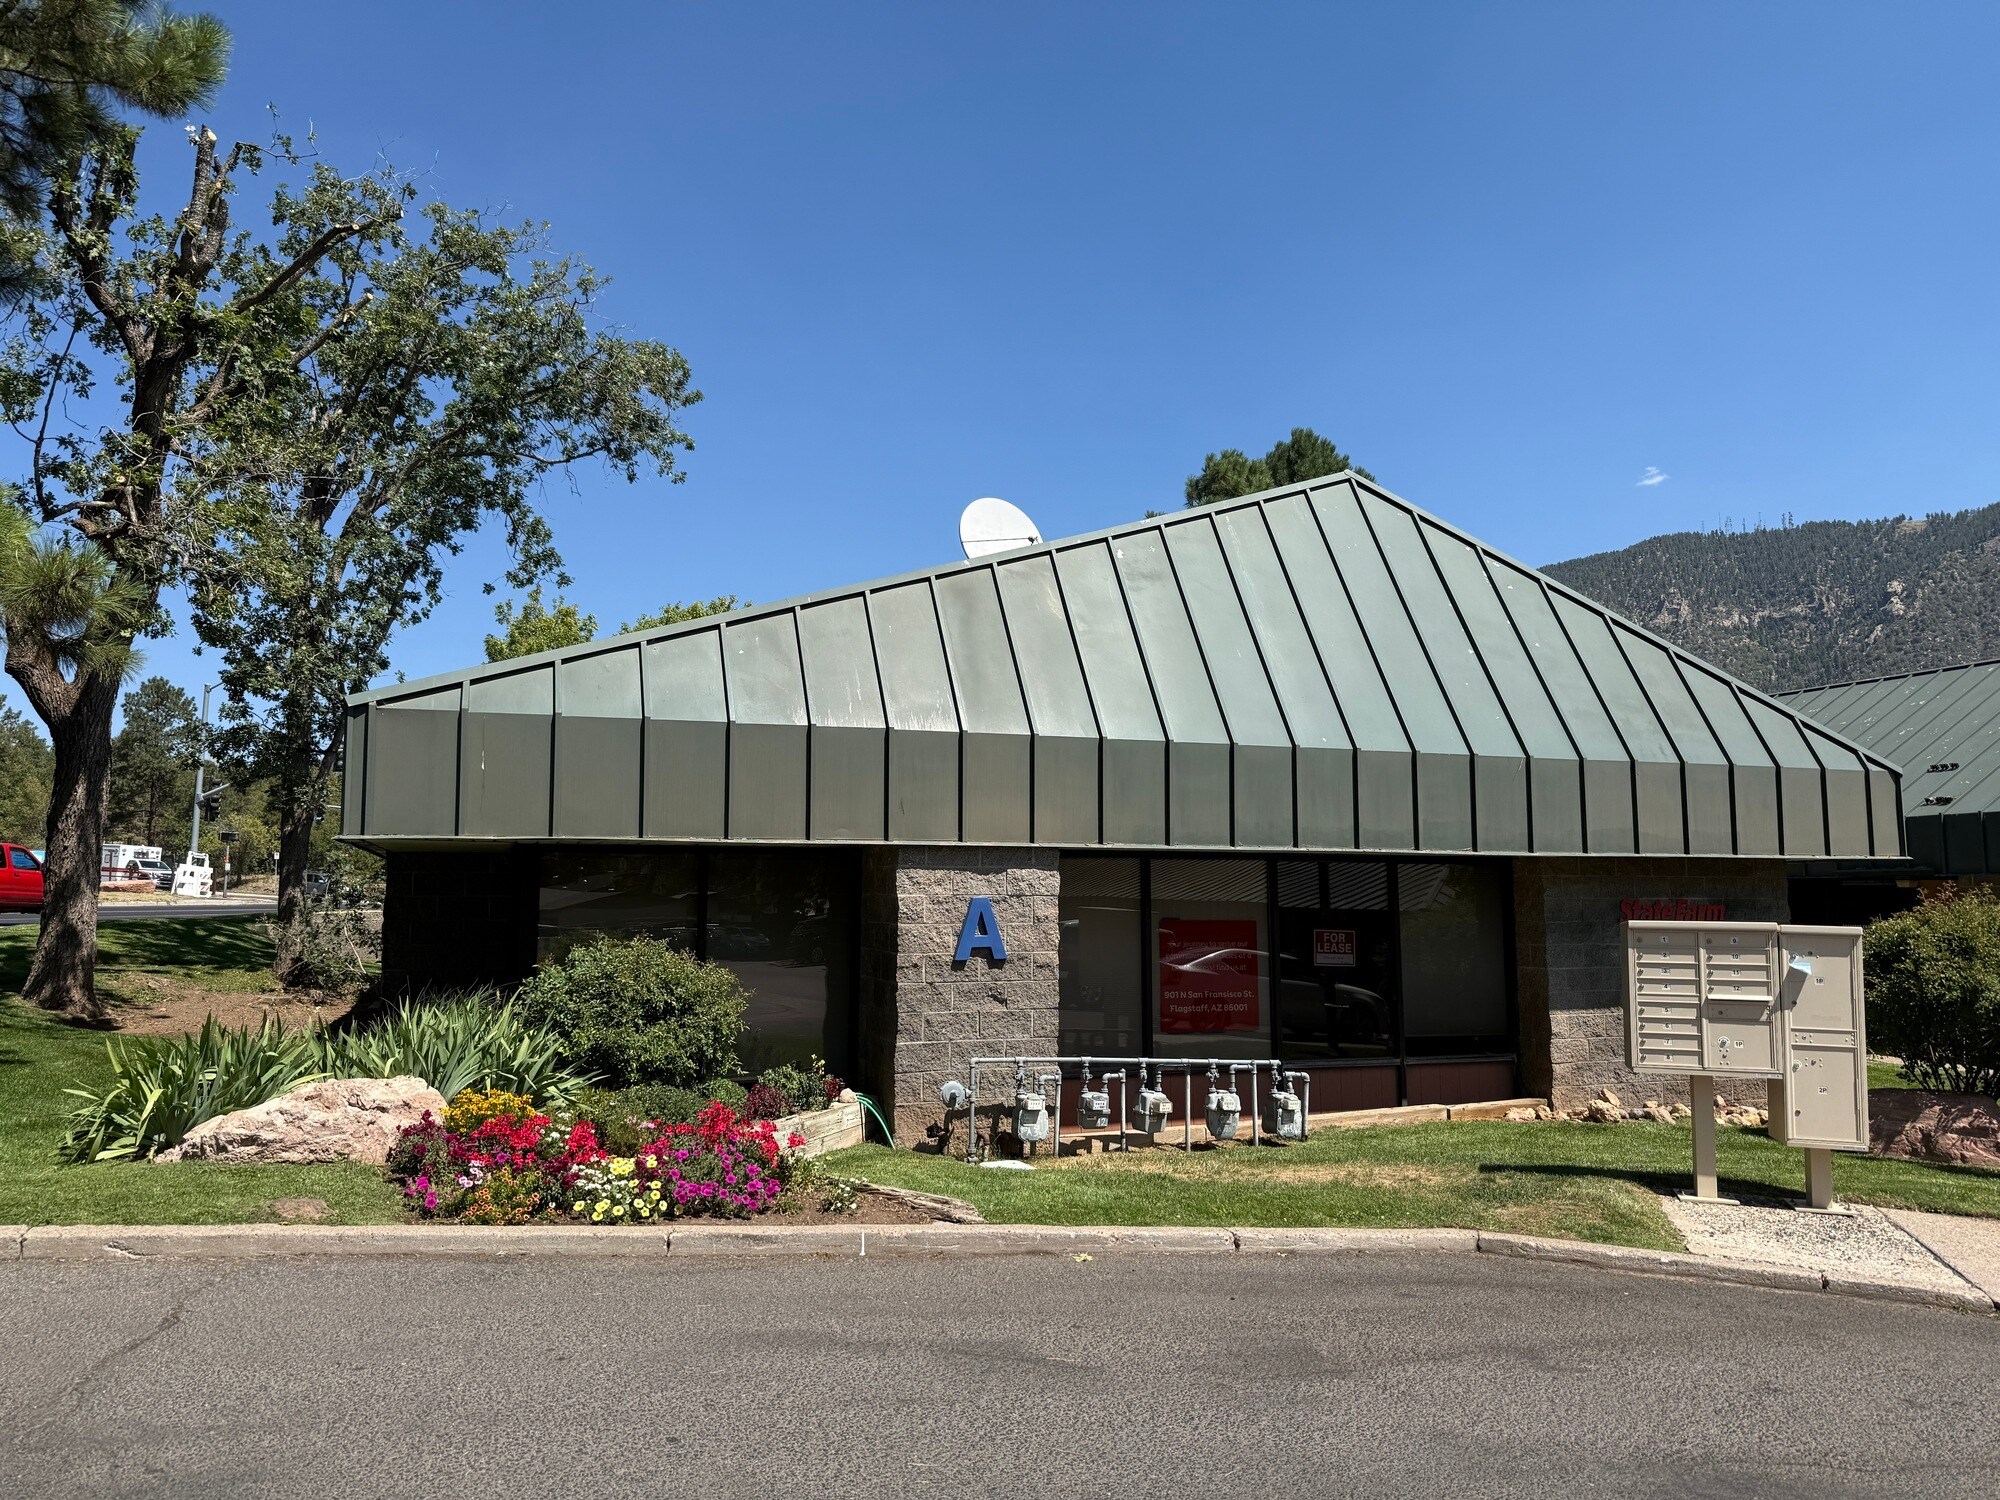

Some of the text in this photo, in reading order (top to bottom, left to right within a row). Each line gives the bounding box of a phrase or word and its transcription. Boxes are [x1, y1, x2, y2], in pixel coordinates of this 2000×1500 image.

[953, 896, 1008, 961] A
[1323, 932, 1346, 943] FOR
[1317, 942, 1352, 953] LEASE
[1164, 991, 1179, 999] 901
[1180, 991, 1187, 999] N
[1188, 990, 1203, 999] San
[1243, 990, 1255, 998] St.
[1170, 1003, 1248, 1013] Flagstaff, AZ 86001
